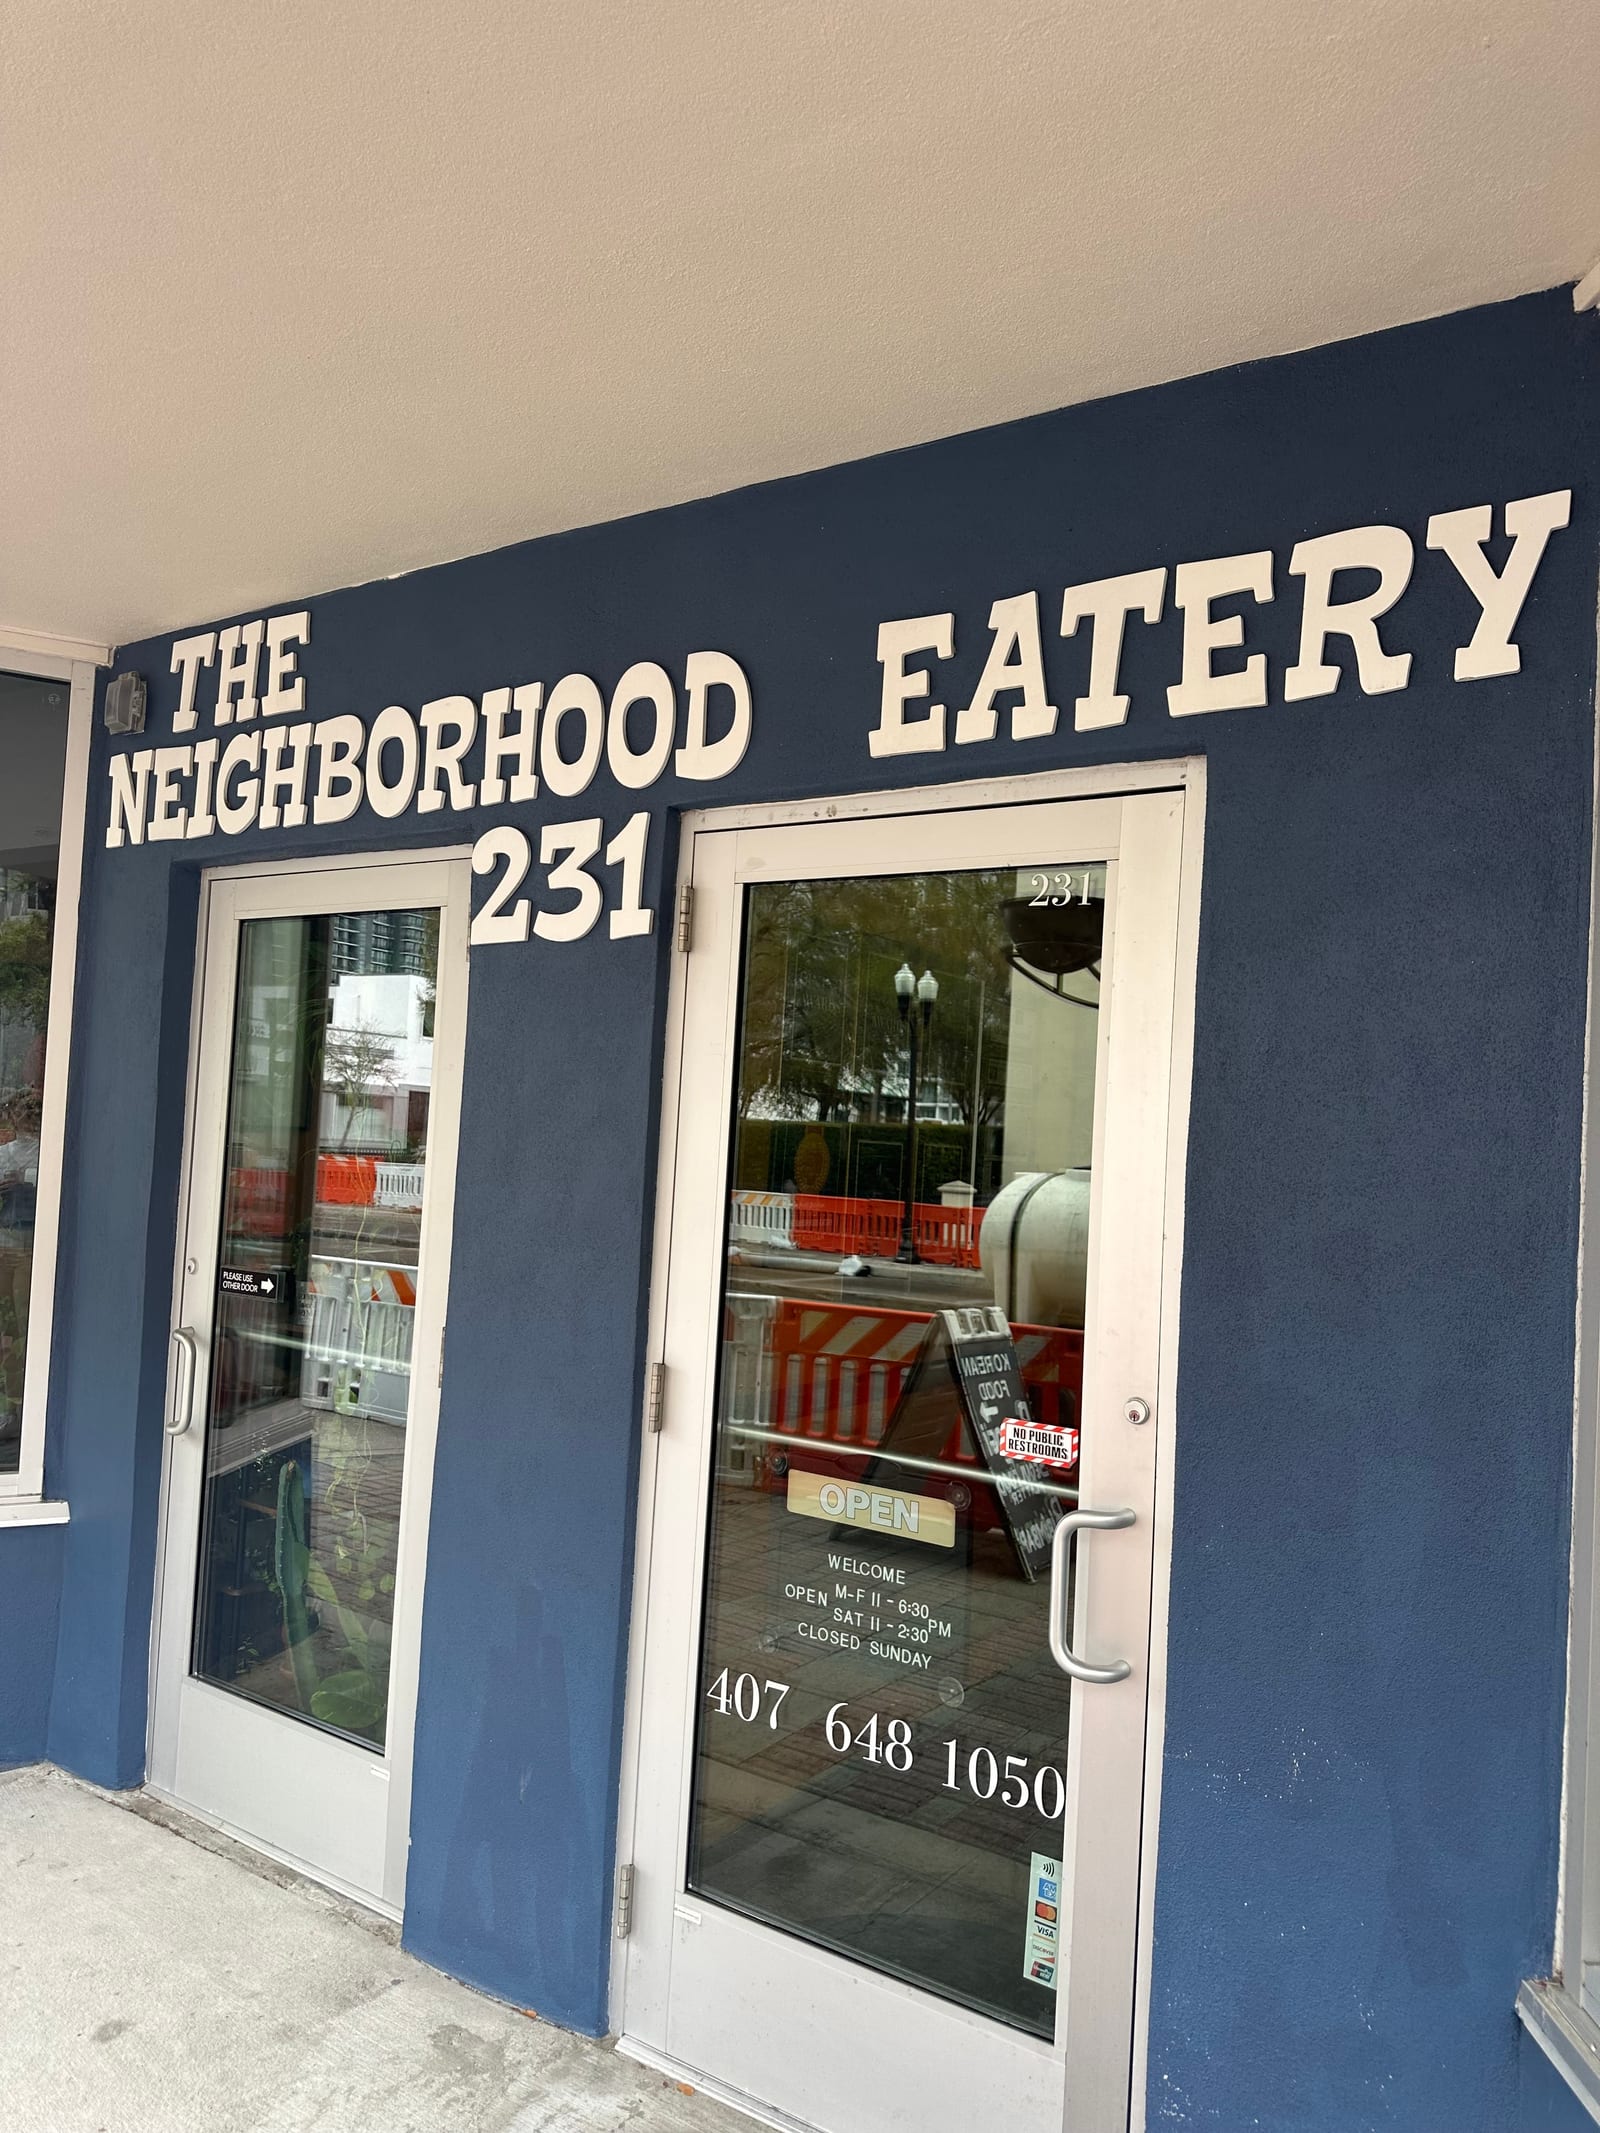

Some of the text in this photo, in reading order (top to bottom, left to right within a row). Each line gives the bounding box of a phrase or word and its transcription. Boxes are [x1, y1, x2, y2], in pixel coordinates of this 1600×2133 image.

[105, 488, 1572, 849] NEIGHBORHOOD EATERY
[170, 611, 311, 733] THE
[470, 811, 654, 946] 231
[1028, 872, 1091, 907] 231
[222, 1280, 259, 1293] OTHER DOOR
[223, 1271, 254, 1283] PLEASE USE
[1008, 1438, 1069, 1460] RESTROOMS
[1013, 1427, 1064, 1447] NO PUBLIC
[819, 1483, 920, 1534] OPEN
[828, 1553, 906, 1585] WELCOME
[785, 1584, 828, 1607] OPEN
[835, 1583, 866, 1603] M-F
[898, 1599, 930, 1620] 6:30
[833, 1607, 864, 1628] SAT
[897, 1624, 929, 1644] 2:30
[928, 1619, 951, 1638] PM
[798, 1622, 932, 1670] CLOSED SUNDAY
[706, 1667, 1065, 1820] 407 648 1050
[1043, 1882, 1057, 1893] AM
[1037, 1925, 1054, 1939] VISA
